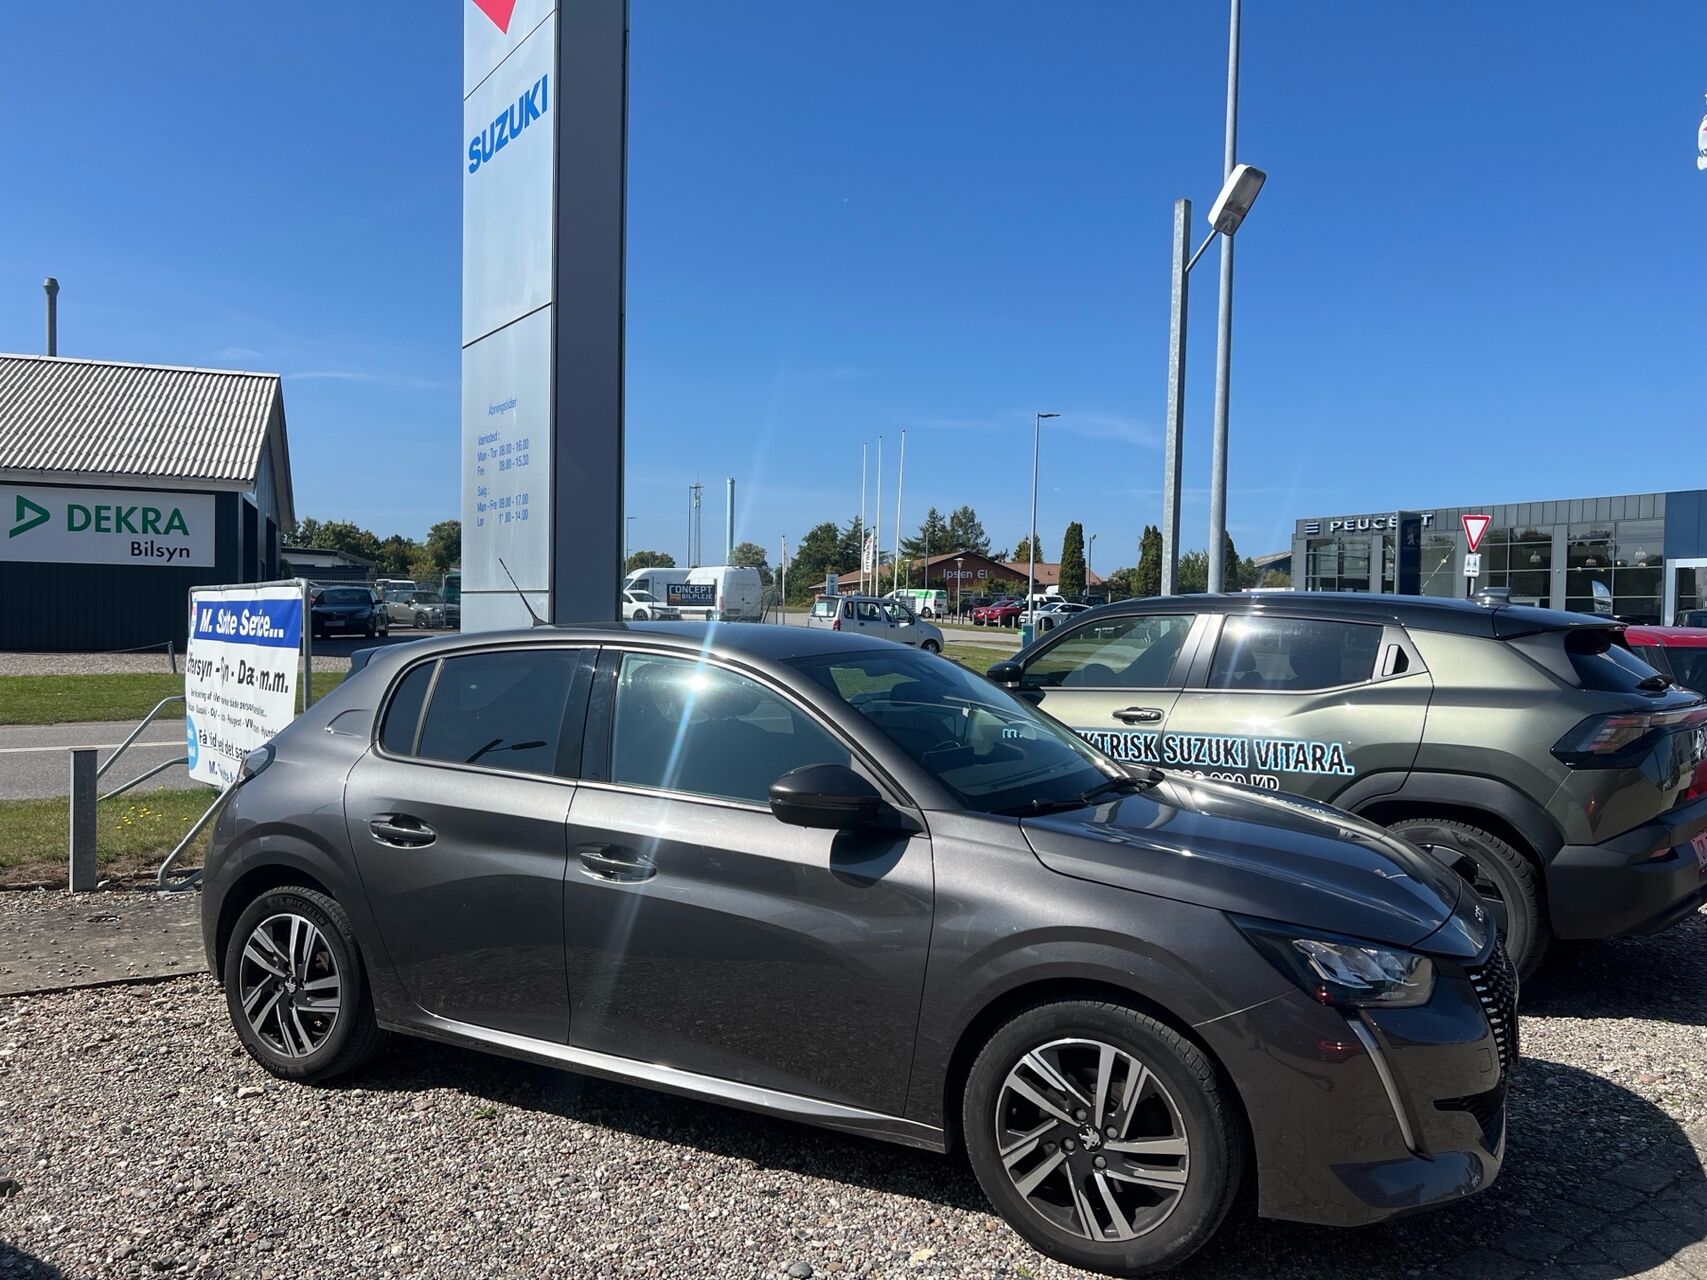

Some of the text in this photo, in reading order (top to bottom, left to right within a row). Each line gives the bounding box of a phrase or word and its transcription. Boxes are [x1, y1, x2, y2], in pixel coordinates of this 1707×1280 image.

[468, 73, 548, 174] SUZUKI
[67, 503, 190, 536] DEKRA
[1330, 513, 1433, 532] PEUGET
[130, 540, 190, 563] Bilsyn
[943, 568, 973, 580] Ipsen
[669, 585, 713, 595] CONCEPT
[200, 608, 213, 633] M.
[1162, 734, 1249, 768] SUZUKI
[1253, 738, 1355, 776] VITARA.
